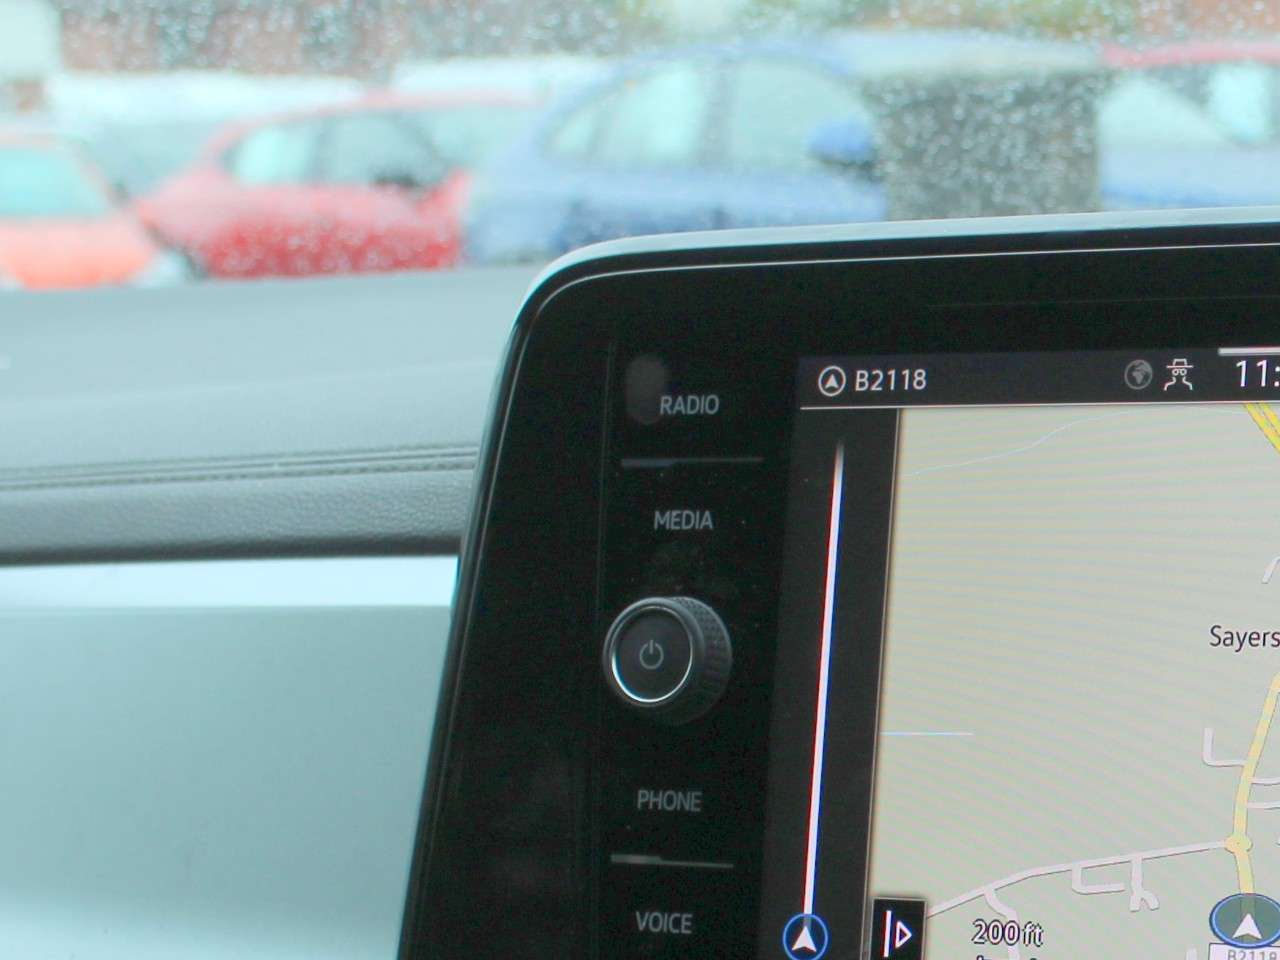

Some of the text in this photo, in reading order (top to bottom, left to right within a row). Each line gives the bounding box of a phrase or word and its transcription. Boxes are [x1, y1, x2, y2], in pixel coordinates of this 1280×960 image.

[854, 368, 928, 393] B2118
[659, 394, 720, 416] RADIO
[653, 509, 715, 531] MEDIA
[636, 789, 702, 812] PHONE
[635, 911, 693, 935] VOICE
